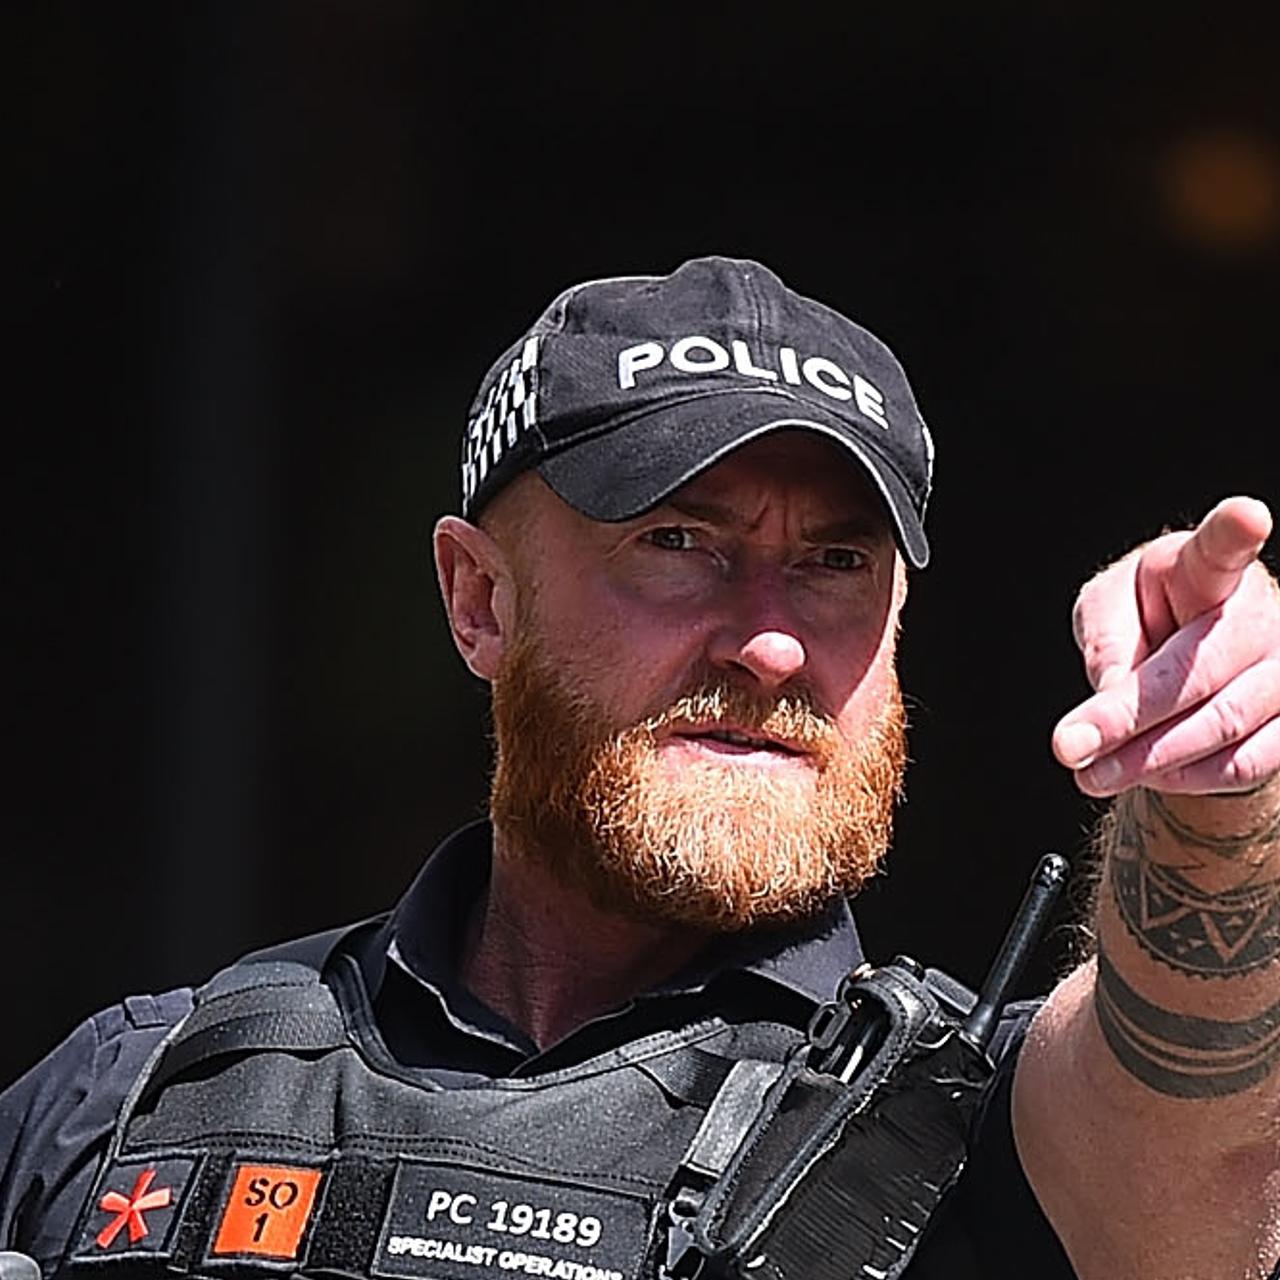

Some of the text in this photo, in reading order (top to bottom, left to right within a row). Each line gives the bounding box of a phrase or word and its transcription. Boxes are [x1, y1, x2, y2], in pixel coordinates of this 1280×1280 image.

[618, 336, 889, 430] POLICE
[245, 1177, 300, 1210] SO
[426, 1190, 603, 1247] PC 19189
[387, 1236, 498, 1267] SPECIALIST
